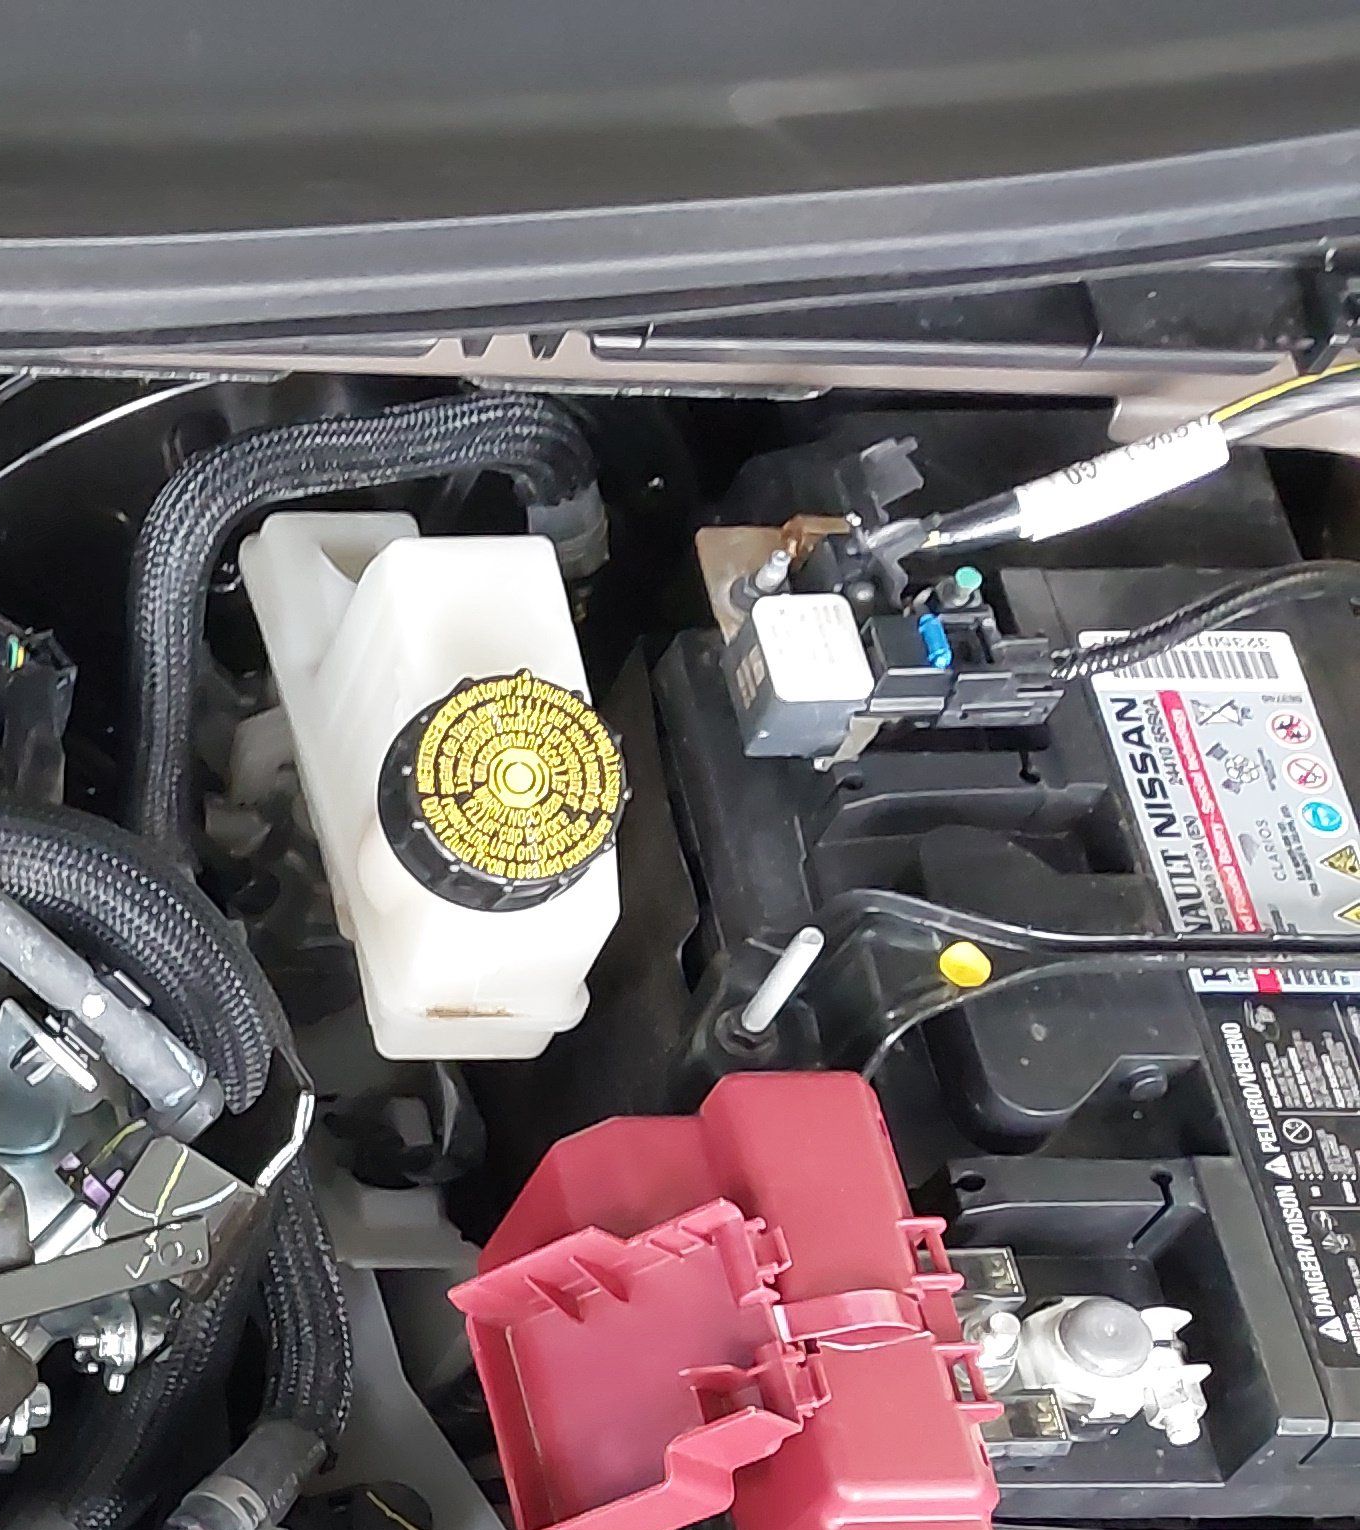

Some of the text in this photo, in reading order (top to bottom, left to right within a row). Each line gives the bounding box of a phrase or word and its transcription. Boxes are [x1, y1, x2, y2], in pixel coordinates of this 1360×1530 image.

[1110, 697, 1182, 838] NISSAN
[1256, 819, 1287, 881] CLARIOS
[1221, 1022, 1281, 1153] PELIGRO/VENENO
[1274, 1184, 1336, 1317] DANGER/POISON
